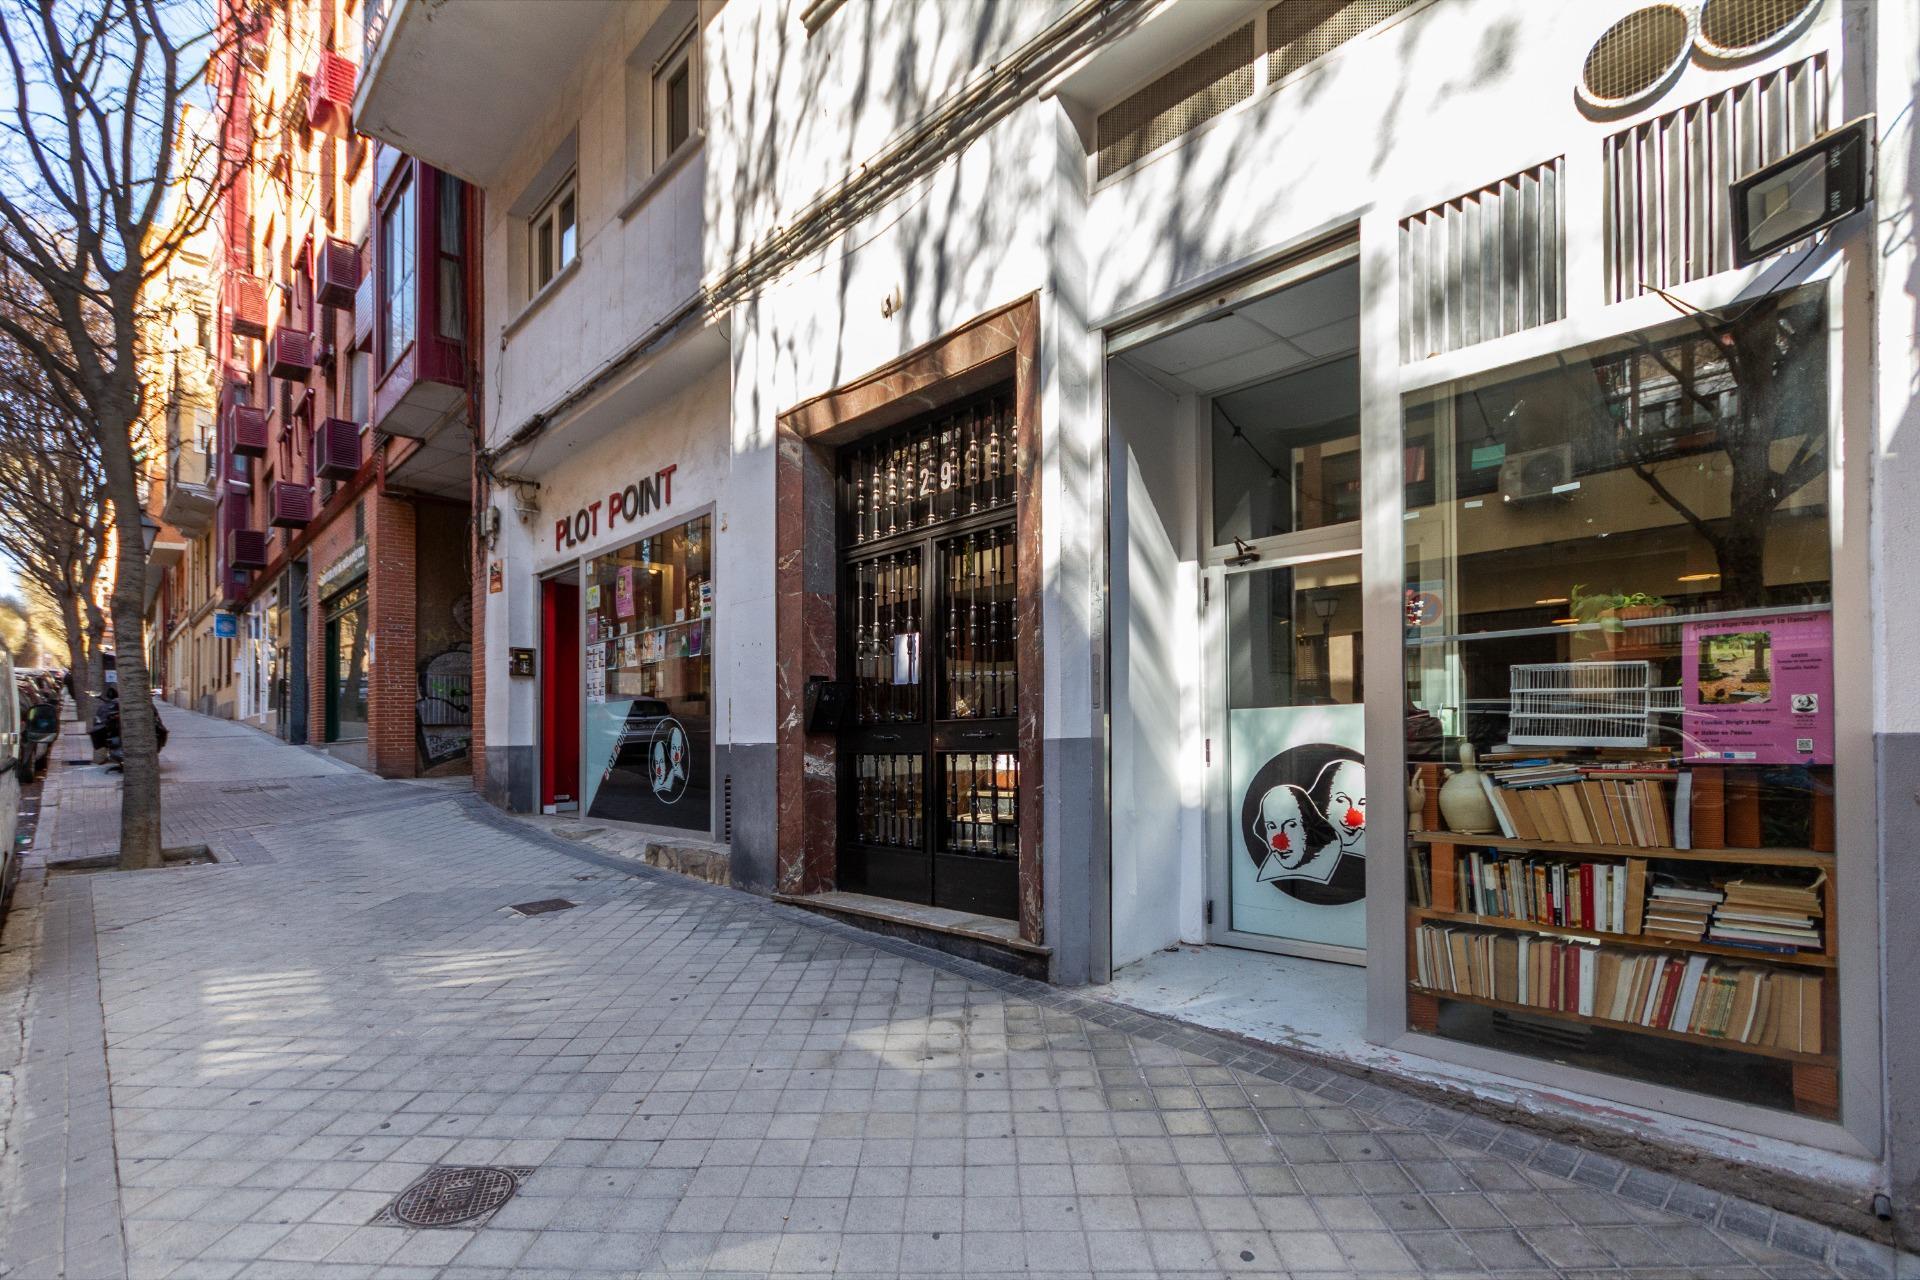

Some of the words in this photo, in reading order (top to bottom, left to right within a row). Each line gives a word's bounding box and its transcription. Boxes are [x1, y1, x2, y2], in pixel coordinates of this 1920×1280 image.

[555, 500, 603, 553] PLOT
[608, 463, 678, 529] POINT
[919, 461, 952, 497] 29
